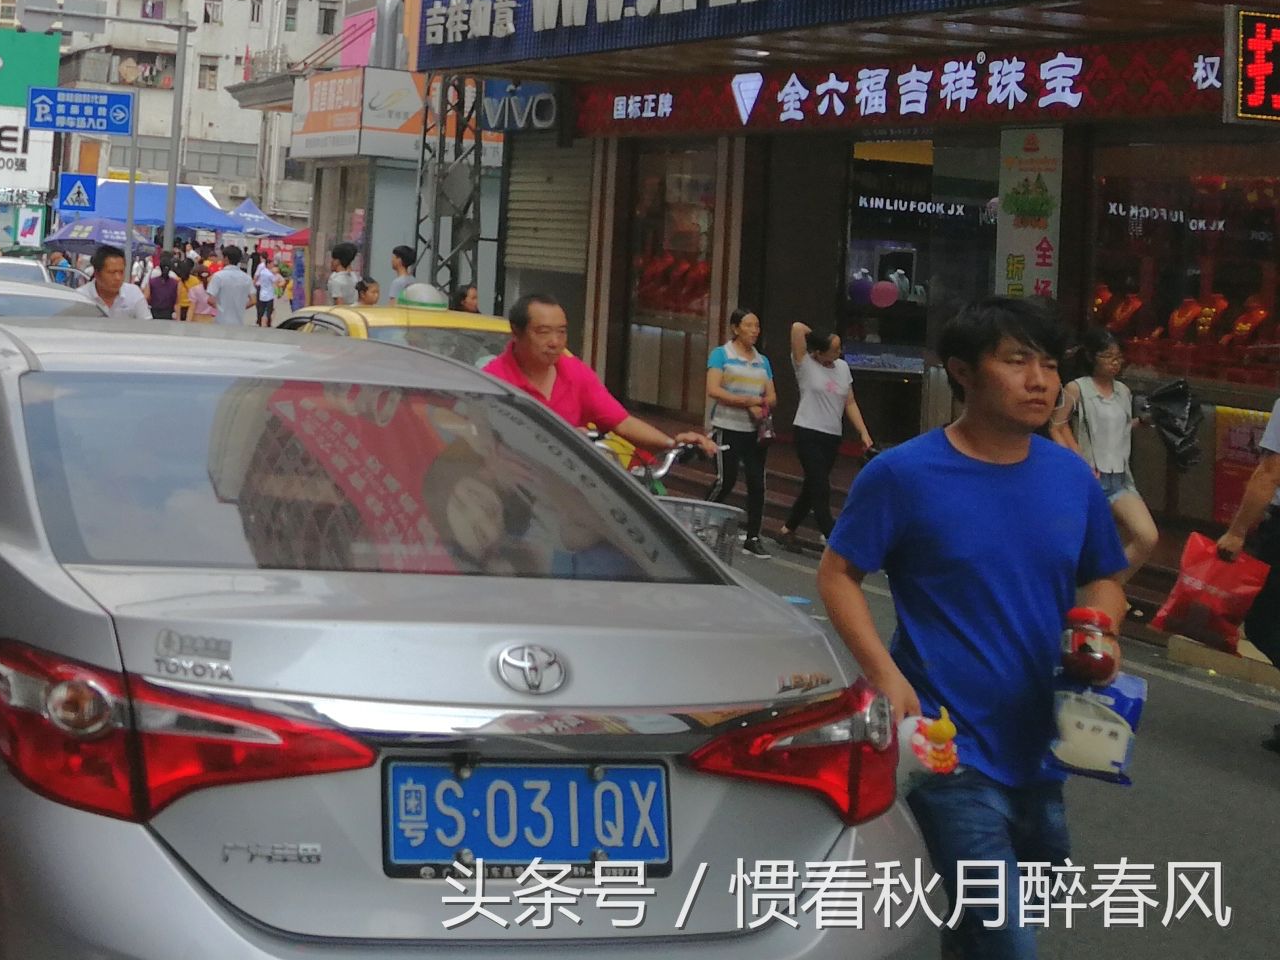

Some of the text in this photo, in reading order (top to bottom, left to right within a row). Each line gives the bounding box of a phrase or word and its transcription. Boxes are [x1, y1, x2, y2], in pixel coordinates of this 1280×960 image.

[858, 195, 884, 209] KIN
[885, 196, 907, 211] LIU
[154, 656, 234, 682] TOYOTA
